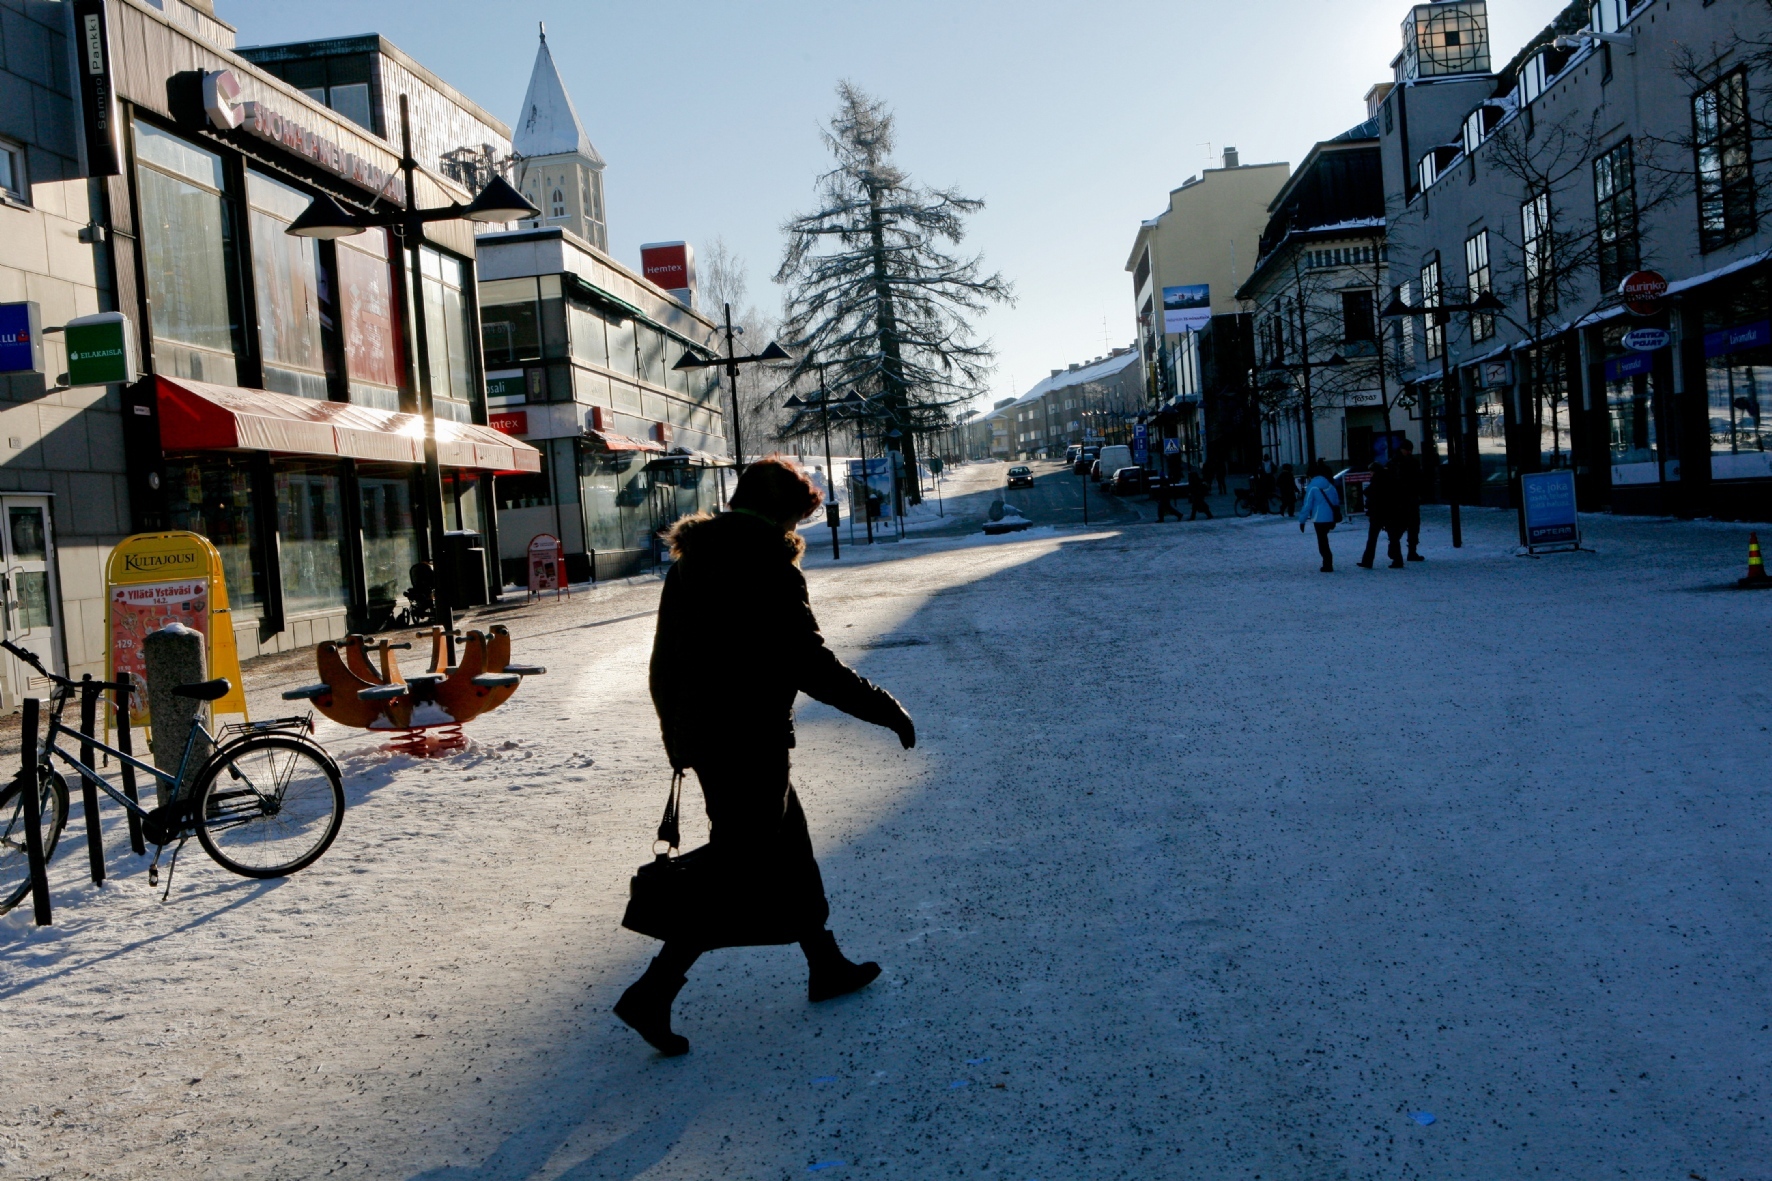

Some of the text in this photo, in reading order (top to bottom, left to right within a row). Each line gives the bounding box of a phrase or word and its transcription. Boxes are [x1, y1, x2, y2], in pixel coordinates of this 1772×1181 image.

[89, 17, 106, 130] Sampo Pankki
[253, 101, 410, 207] SUOMALAINEN KIRJAKAU
[647, 264, 683, 275] Hemtex
[1626, 281, 1666, 293] aurinko
[0, 333, 17, 343] LLI
[1630, 331, 1665, 340] MATKA
[1632, 339, 1663, 347] POJAT
[80, 348, 123, 359] EILAKAISLA
[1135, 425, 1145, 437] P
[1547, 481, 1569, 494] joka
[124, 553, 195, 571] KULTAJOUSI
[128, 585, 191, 601] Yllätä Ystäväsi
